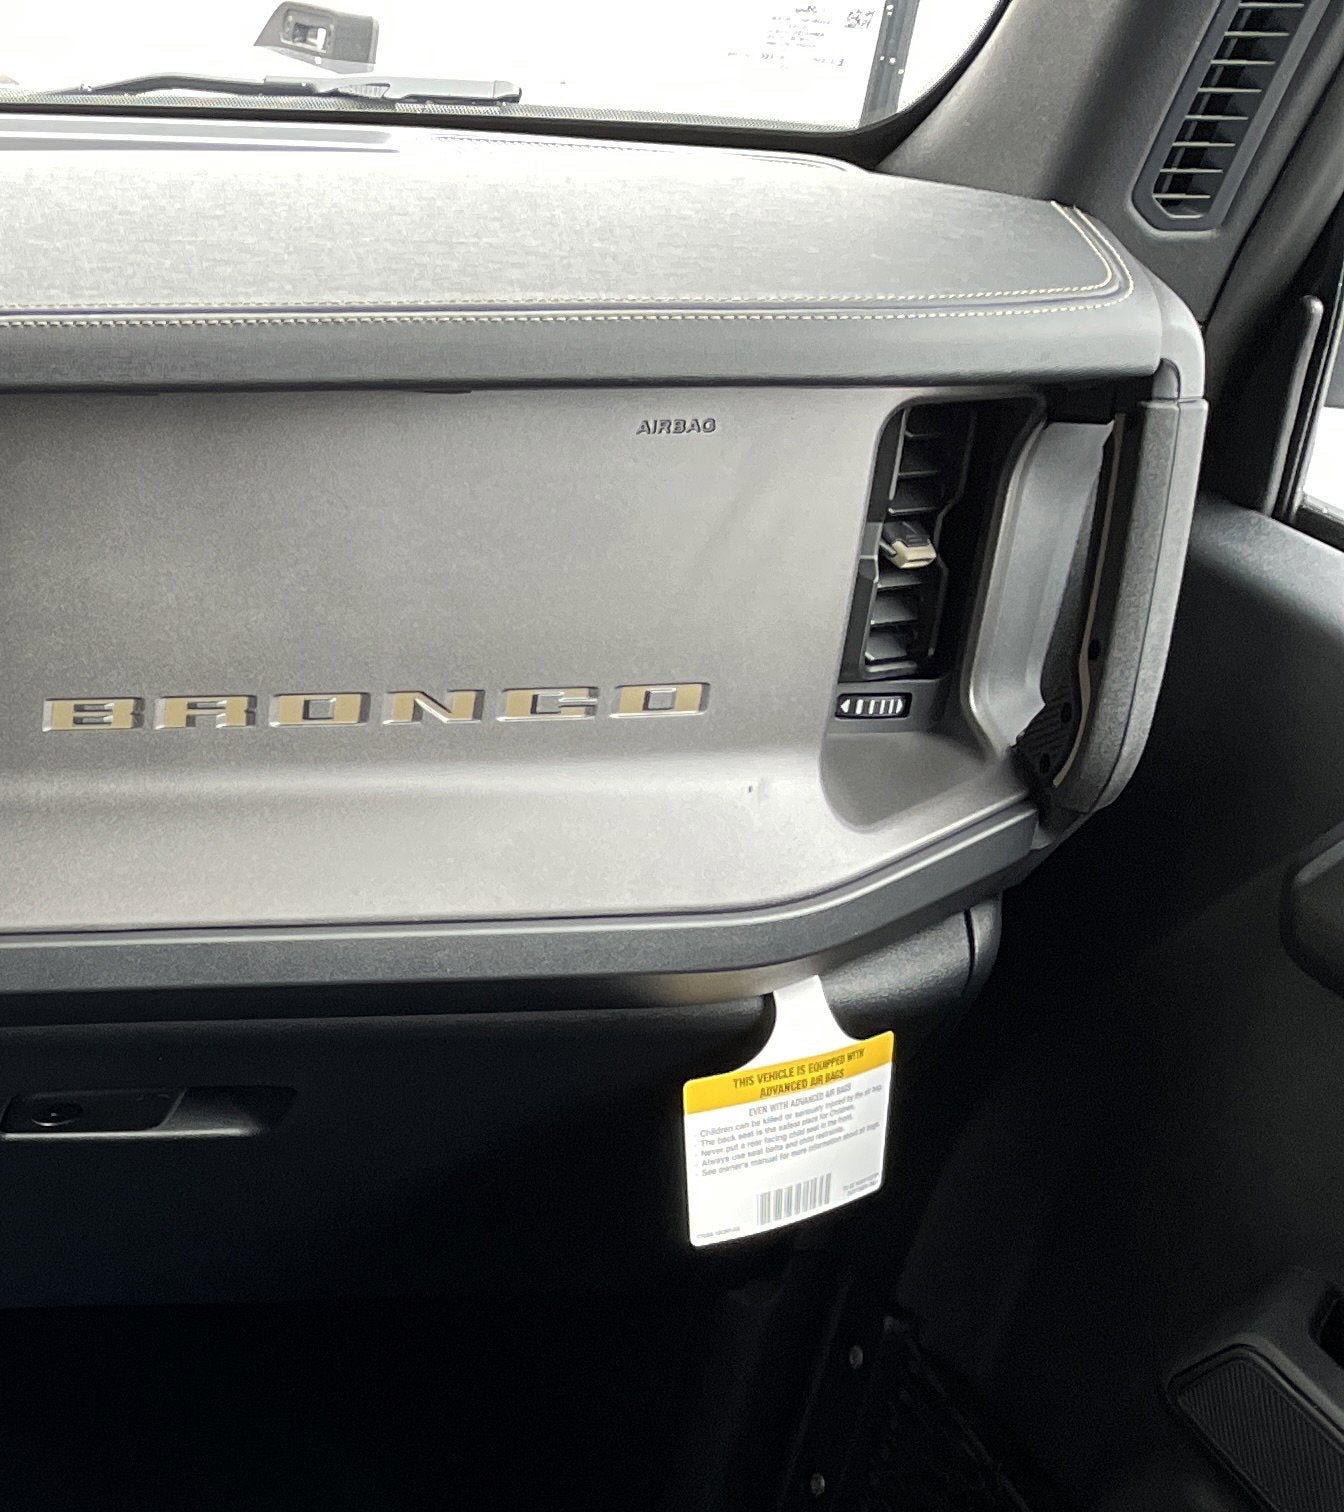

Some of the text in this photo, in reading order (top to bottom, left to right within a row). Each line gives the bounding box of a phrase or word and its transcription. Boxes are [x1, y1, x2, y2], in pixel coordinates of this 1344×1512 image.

[635, 418, 716, 435] AIRBAG
[41, 682, 711, 733] BRONCO
[732, 1075, 755, 1089] THIS
[756, 1066, 795, 1084] VEHICLE
[796, 1064, 806, 1076] IS
[808, 1055, 845, 1074] EQUIPPED
[759, 1068, 845, 1099] ADVANCED AIR BAGS
